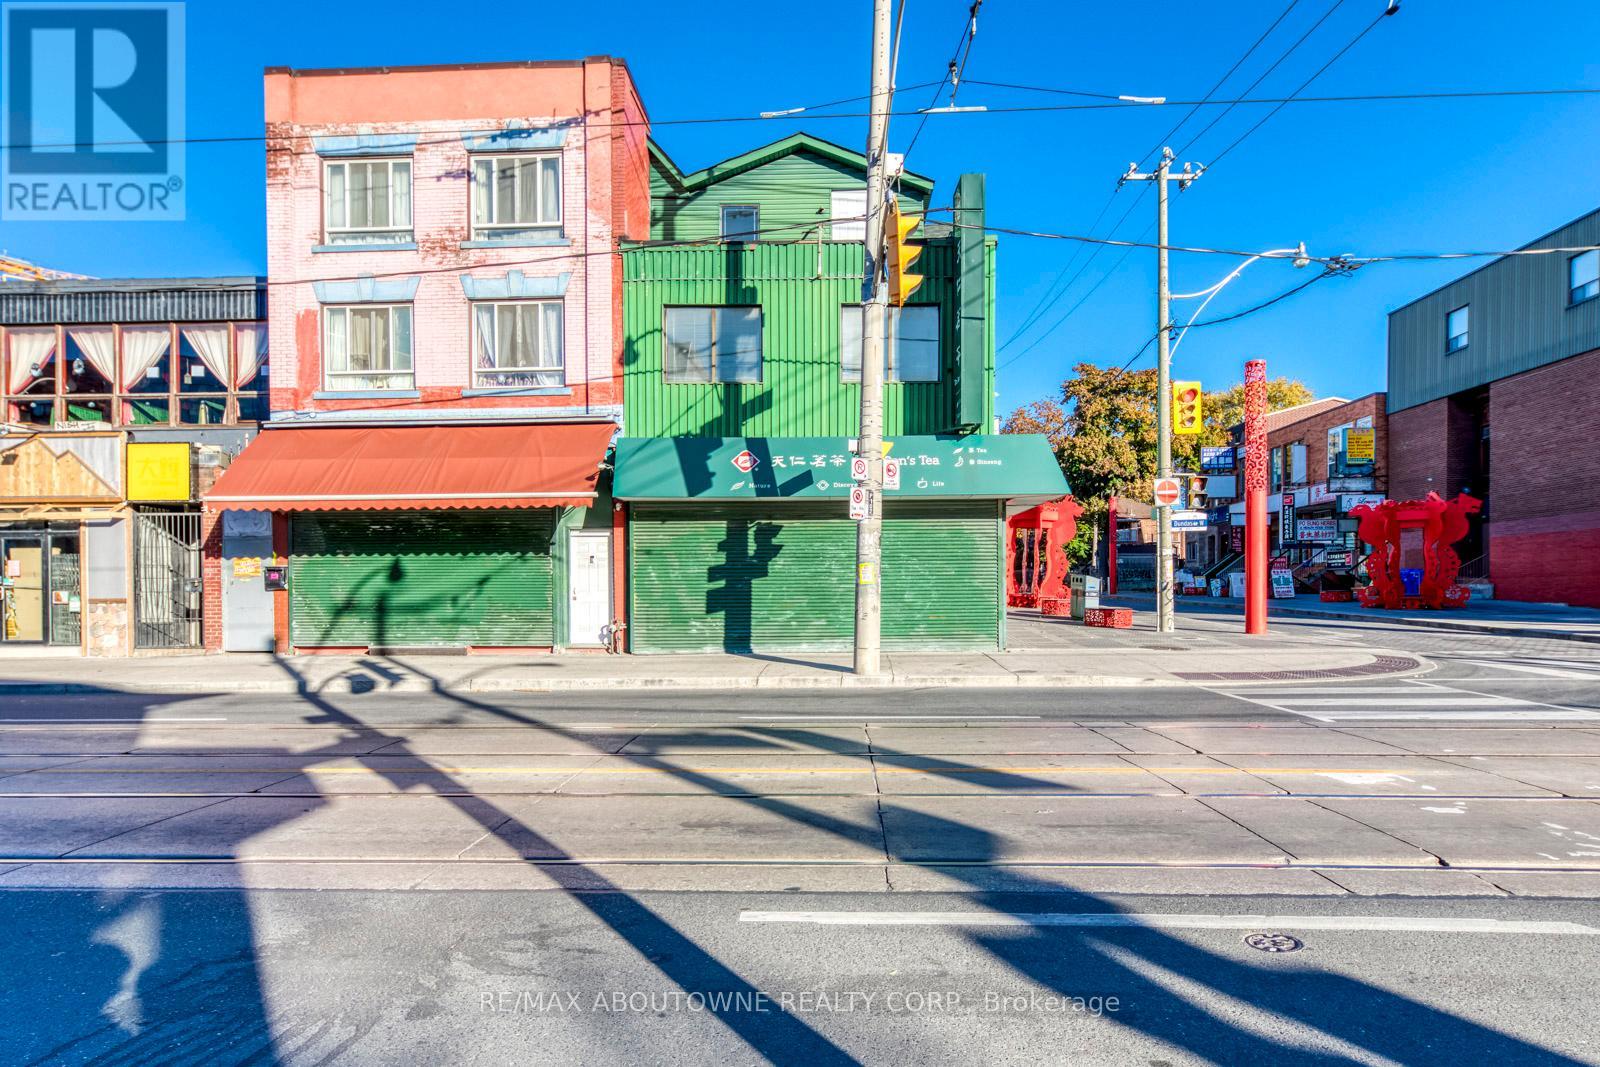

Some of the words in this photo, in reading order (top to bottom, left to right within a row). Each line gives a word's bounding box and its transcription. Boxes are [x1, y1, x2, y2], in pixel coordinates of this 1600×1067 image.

[771, 454, 847, 468] 天仁茗茶
[918, 455, 940, 466] Tea
